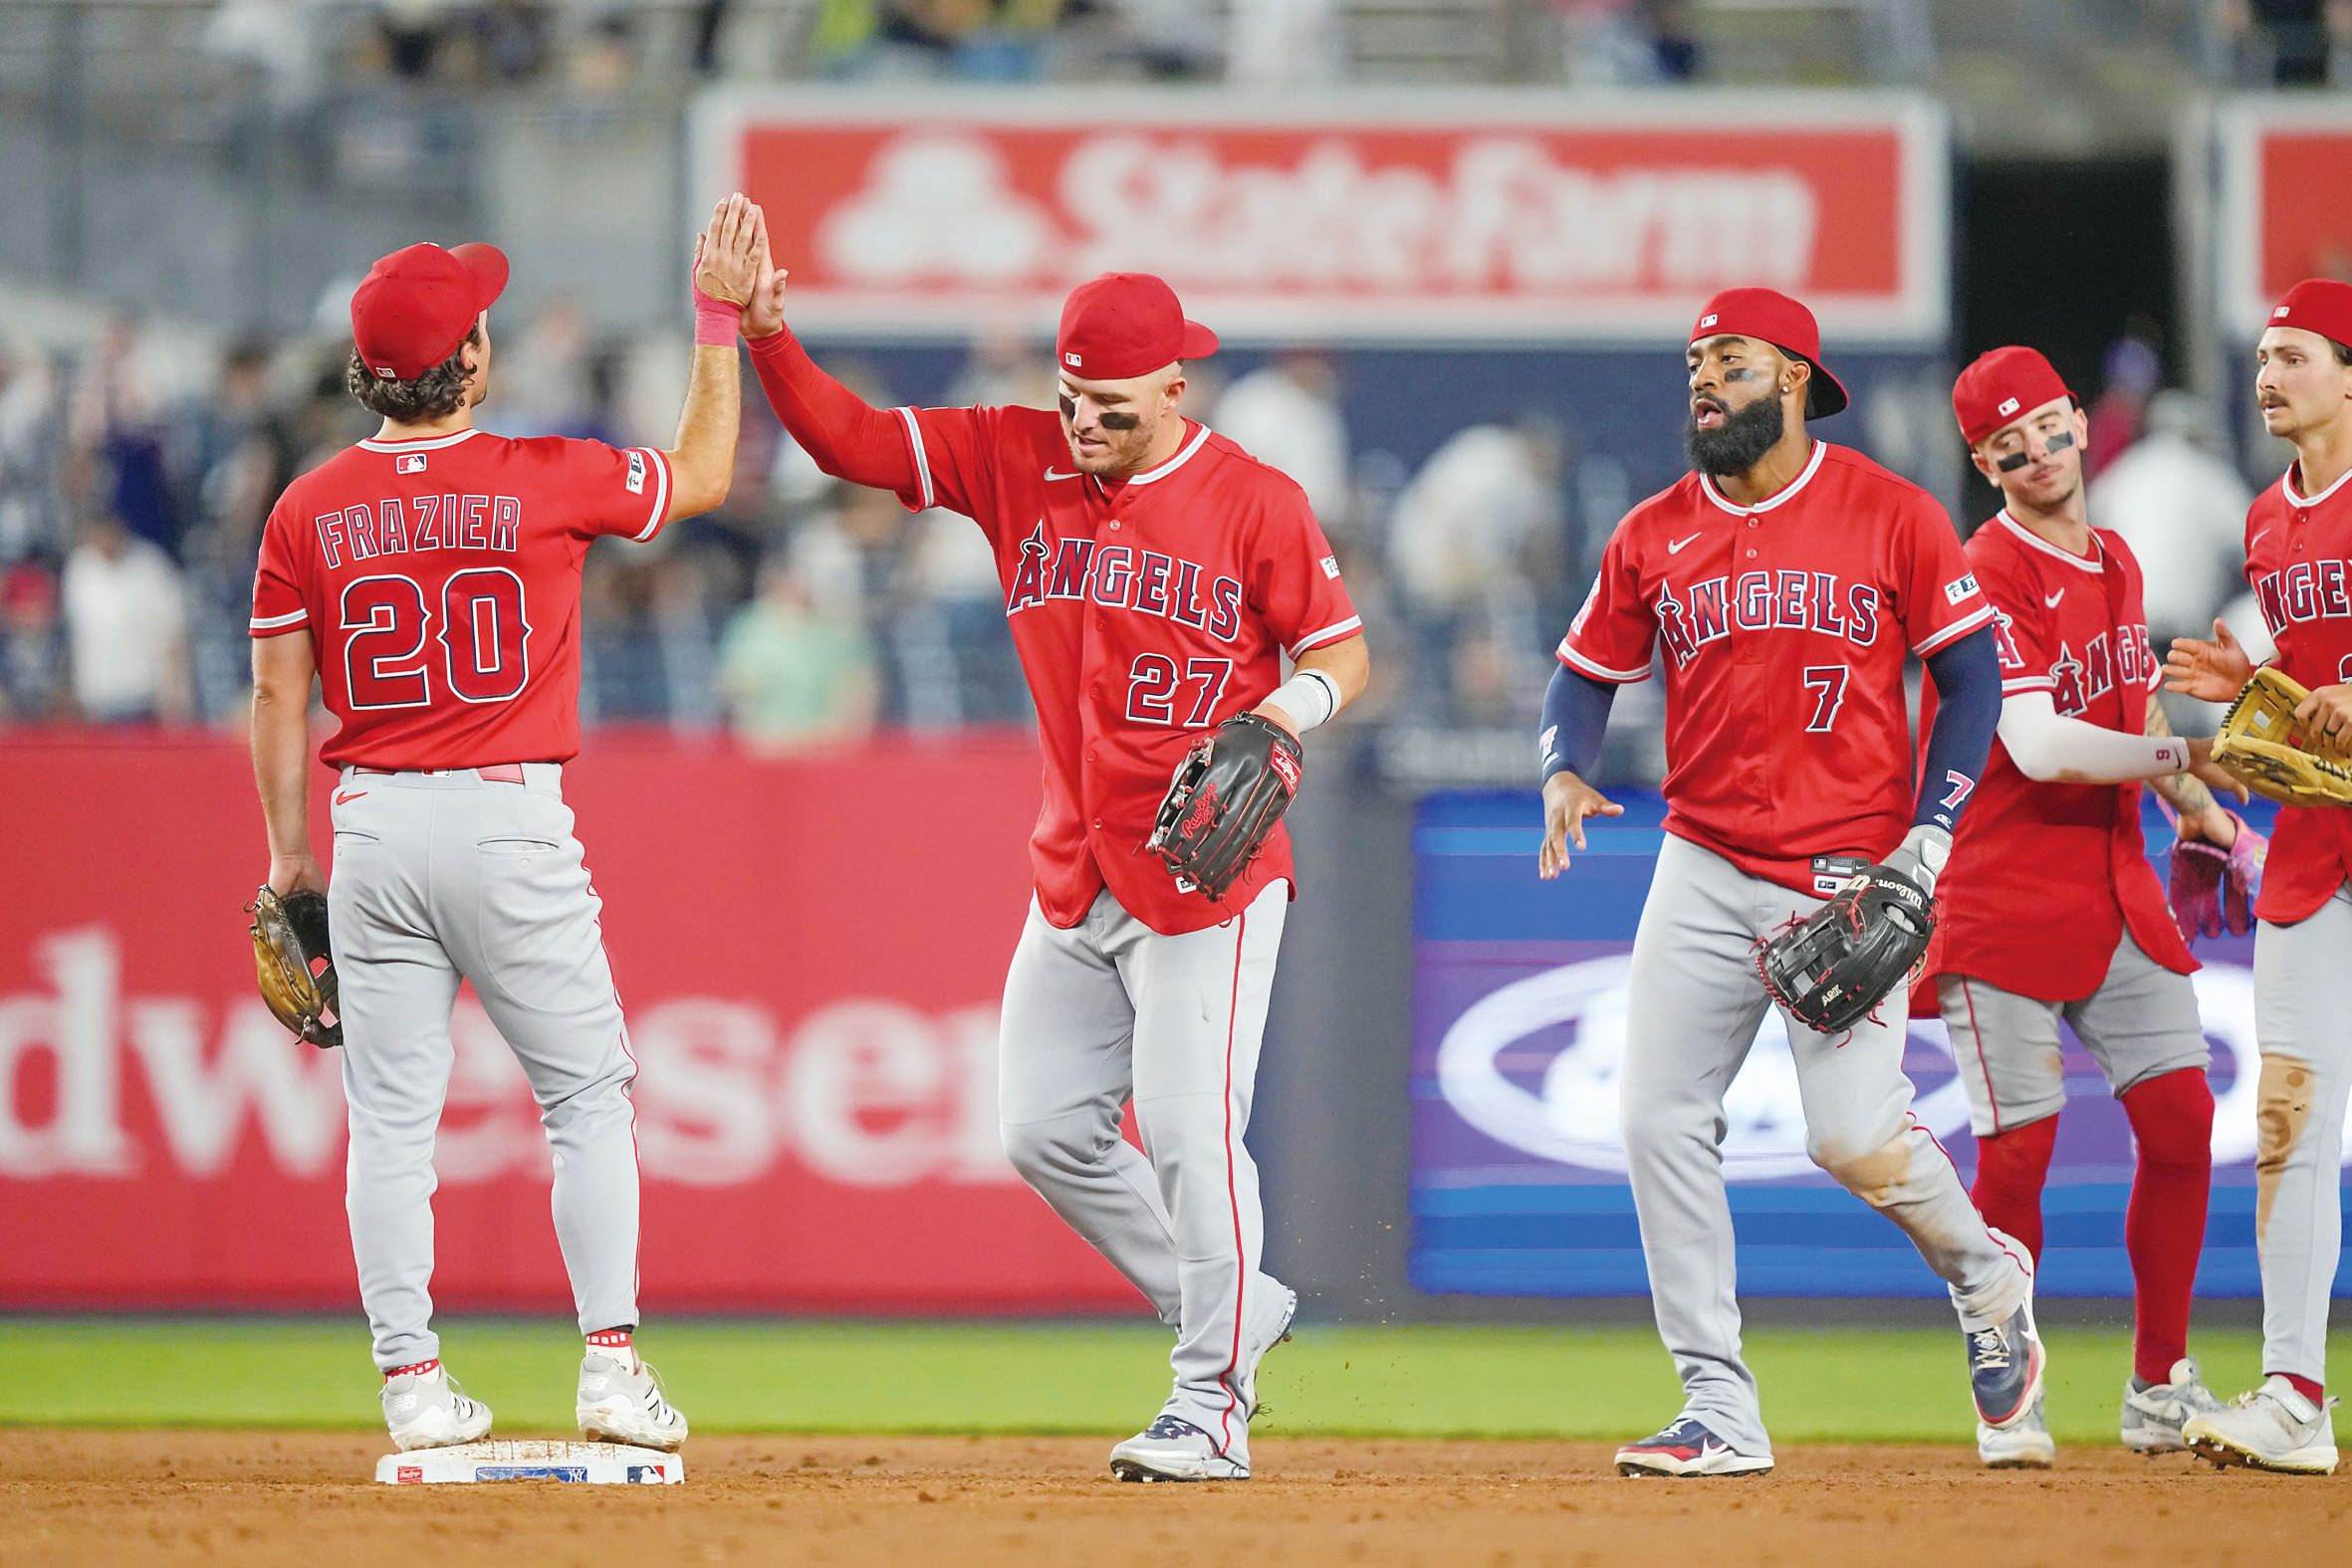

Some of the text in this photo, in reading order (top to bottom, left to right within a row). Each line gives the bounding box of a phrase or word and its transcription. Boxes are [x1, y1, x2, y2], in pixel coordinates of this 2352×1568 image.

[315, 494, 522, 570] FRAZIER
[1006, 519, 1243, 643] ANGELS
[339, 566, 533, 710] 20
[1655, 569, 1879, 673] ANGELS
[1125, 652, 1235, 728] 27
[1804, 665, 1849, 733] 7
[1181, 783, 1218, 839] Rawlings
[1939, 770, 1976, 810] 7
